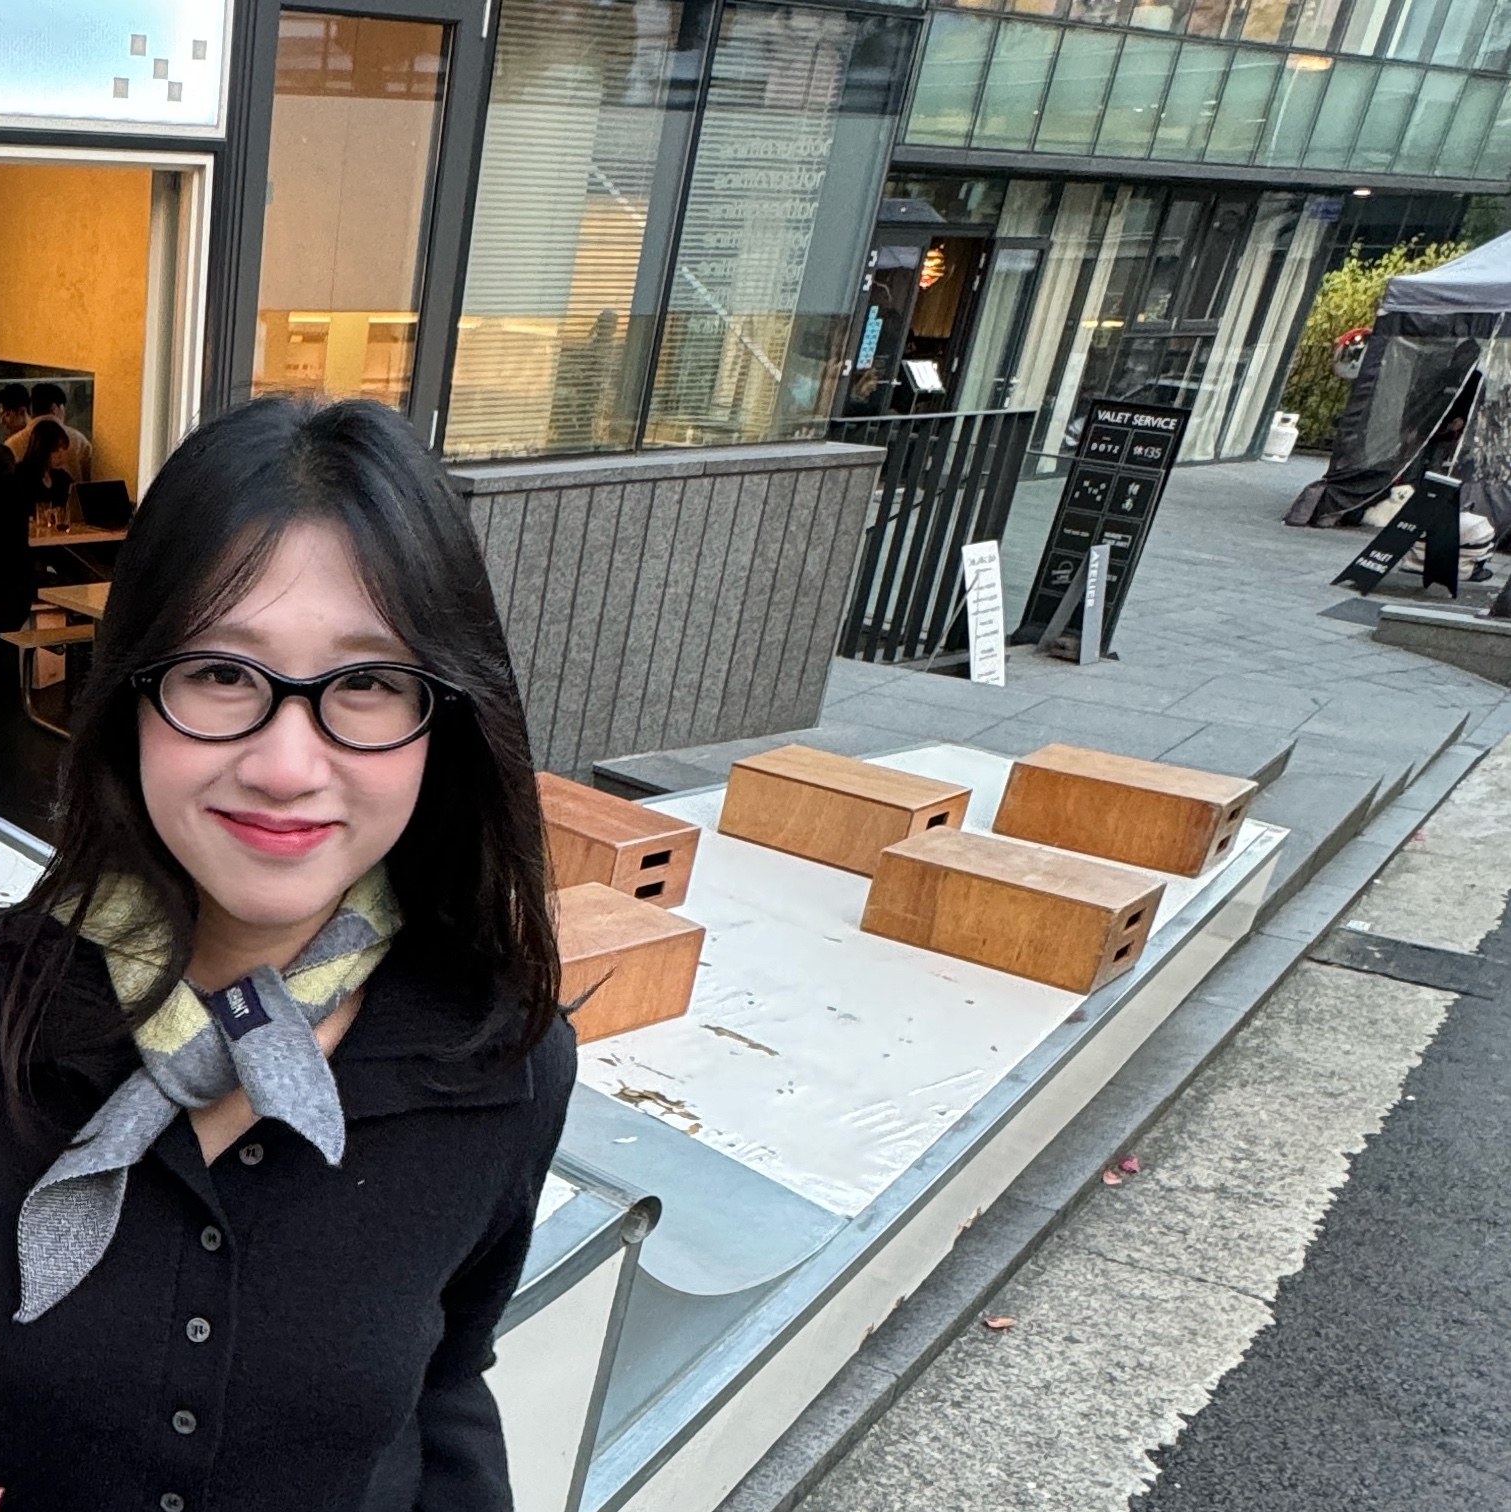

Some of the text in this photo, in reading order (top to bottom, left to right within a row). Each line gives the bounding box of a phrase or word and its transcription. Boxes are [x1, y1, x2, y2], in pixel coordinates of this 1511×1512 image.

[1098, 409, 1178, 430] VALET SERVICE
[1369, 550, 1394, 562] VALET
[1088, 551, 1100, 607] ATELIER
